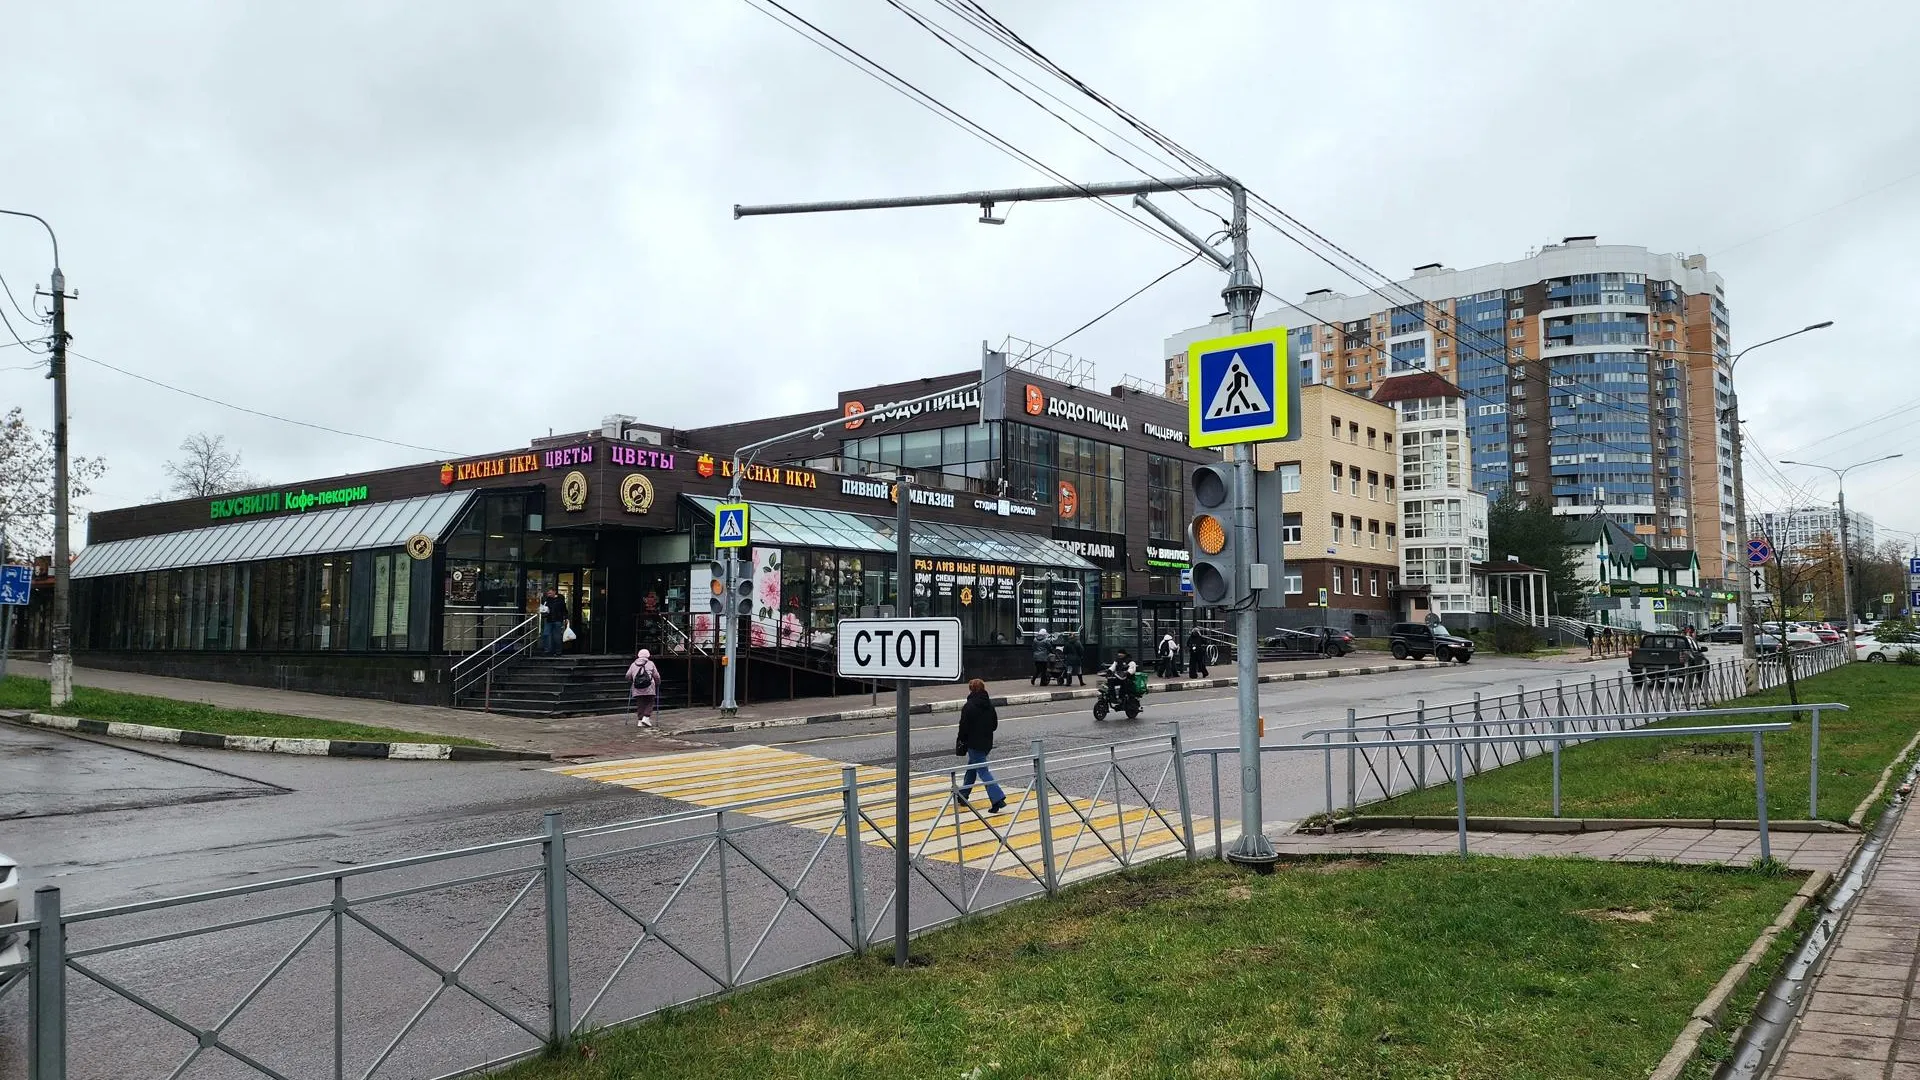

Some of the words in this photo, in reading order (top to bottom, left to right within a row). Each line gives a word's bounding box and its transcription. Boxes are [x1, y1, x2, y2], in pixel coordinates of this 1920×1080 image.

[925, 389, 980, 412] ПИЦЦ
[1048, 397, 1084, 421] ДОДО
[1086, 406, 1128, 432] ПИЦЦА
[1144, 423, 1183, 442] ПИЦЦЕРИЯ
[457, 458, 504, 481] КРАСНАЯ
[509, 454, 539, 474] ИКРА
[545, 446, 593, 468] ЦВЕТЫ
[611, 446, 674, 470] ЦВЕТЫ
[722, 460, 780, 484] КАСНАЯ
[786, 470, 817, 488] ИКРА
[210, 492, 280, 519] ВКУСВИЛЛ
[285, 485, 368, 511] Кафе-пекарня
[842, 479, 888, 499] ПИВНОЙ
[909, 488, 955, 508] МАГАЗИН
[974, 500, 998, 511] СТУДИЯ
[1010, 504, 1036, 516] КРАСОТЫ
[1055, 540, 1086, 556] ТЫРЕ
[1087, 543, 1115, 559] ЛАПЫ
[853, 629, 940, 667] СТОП
